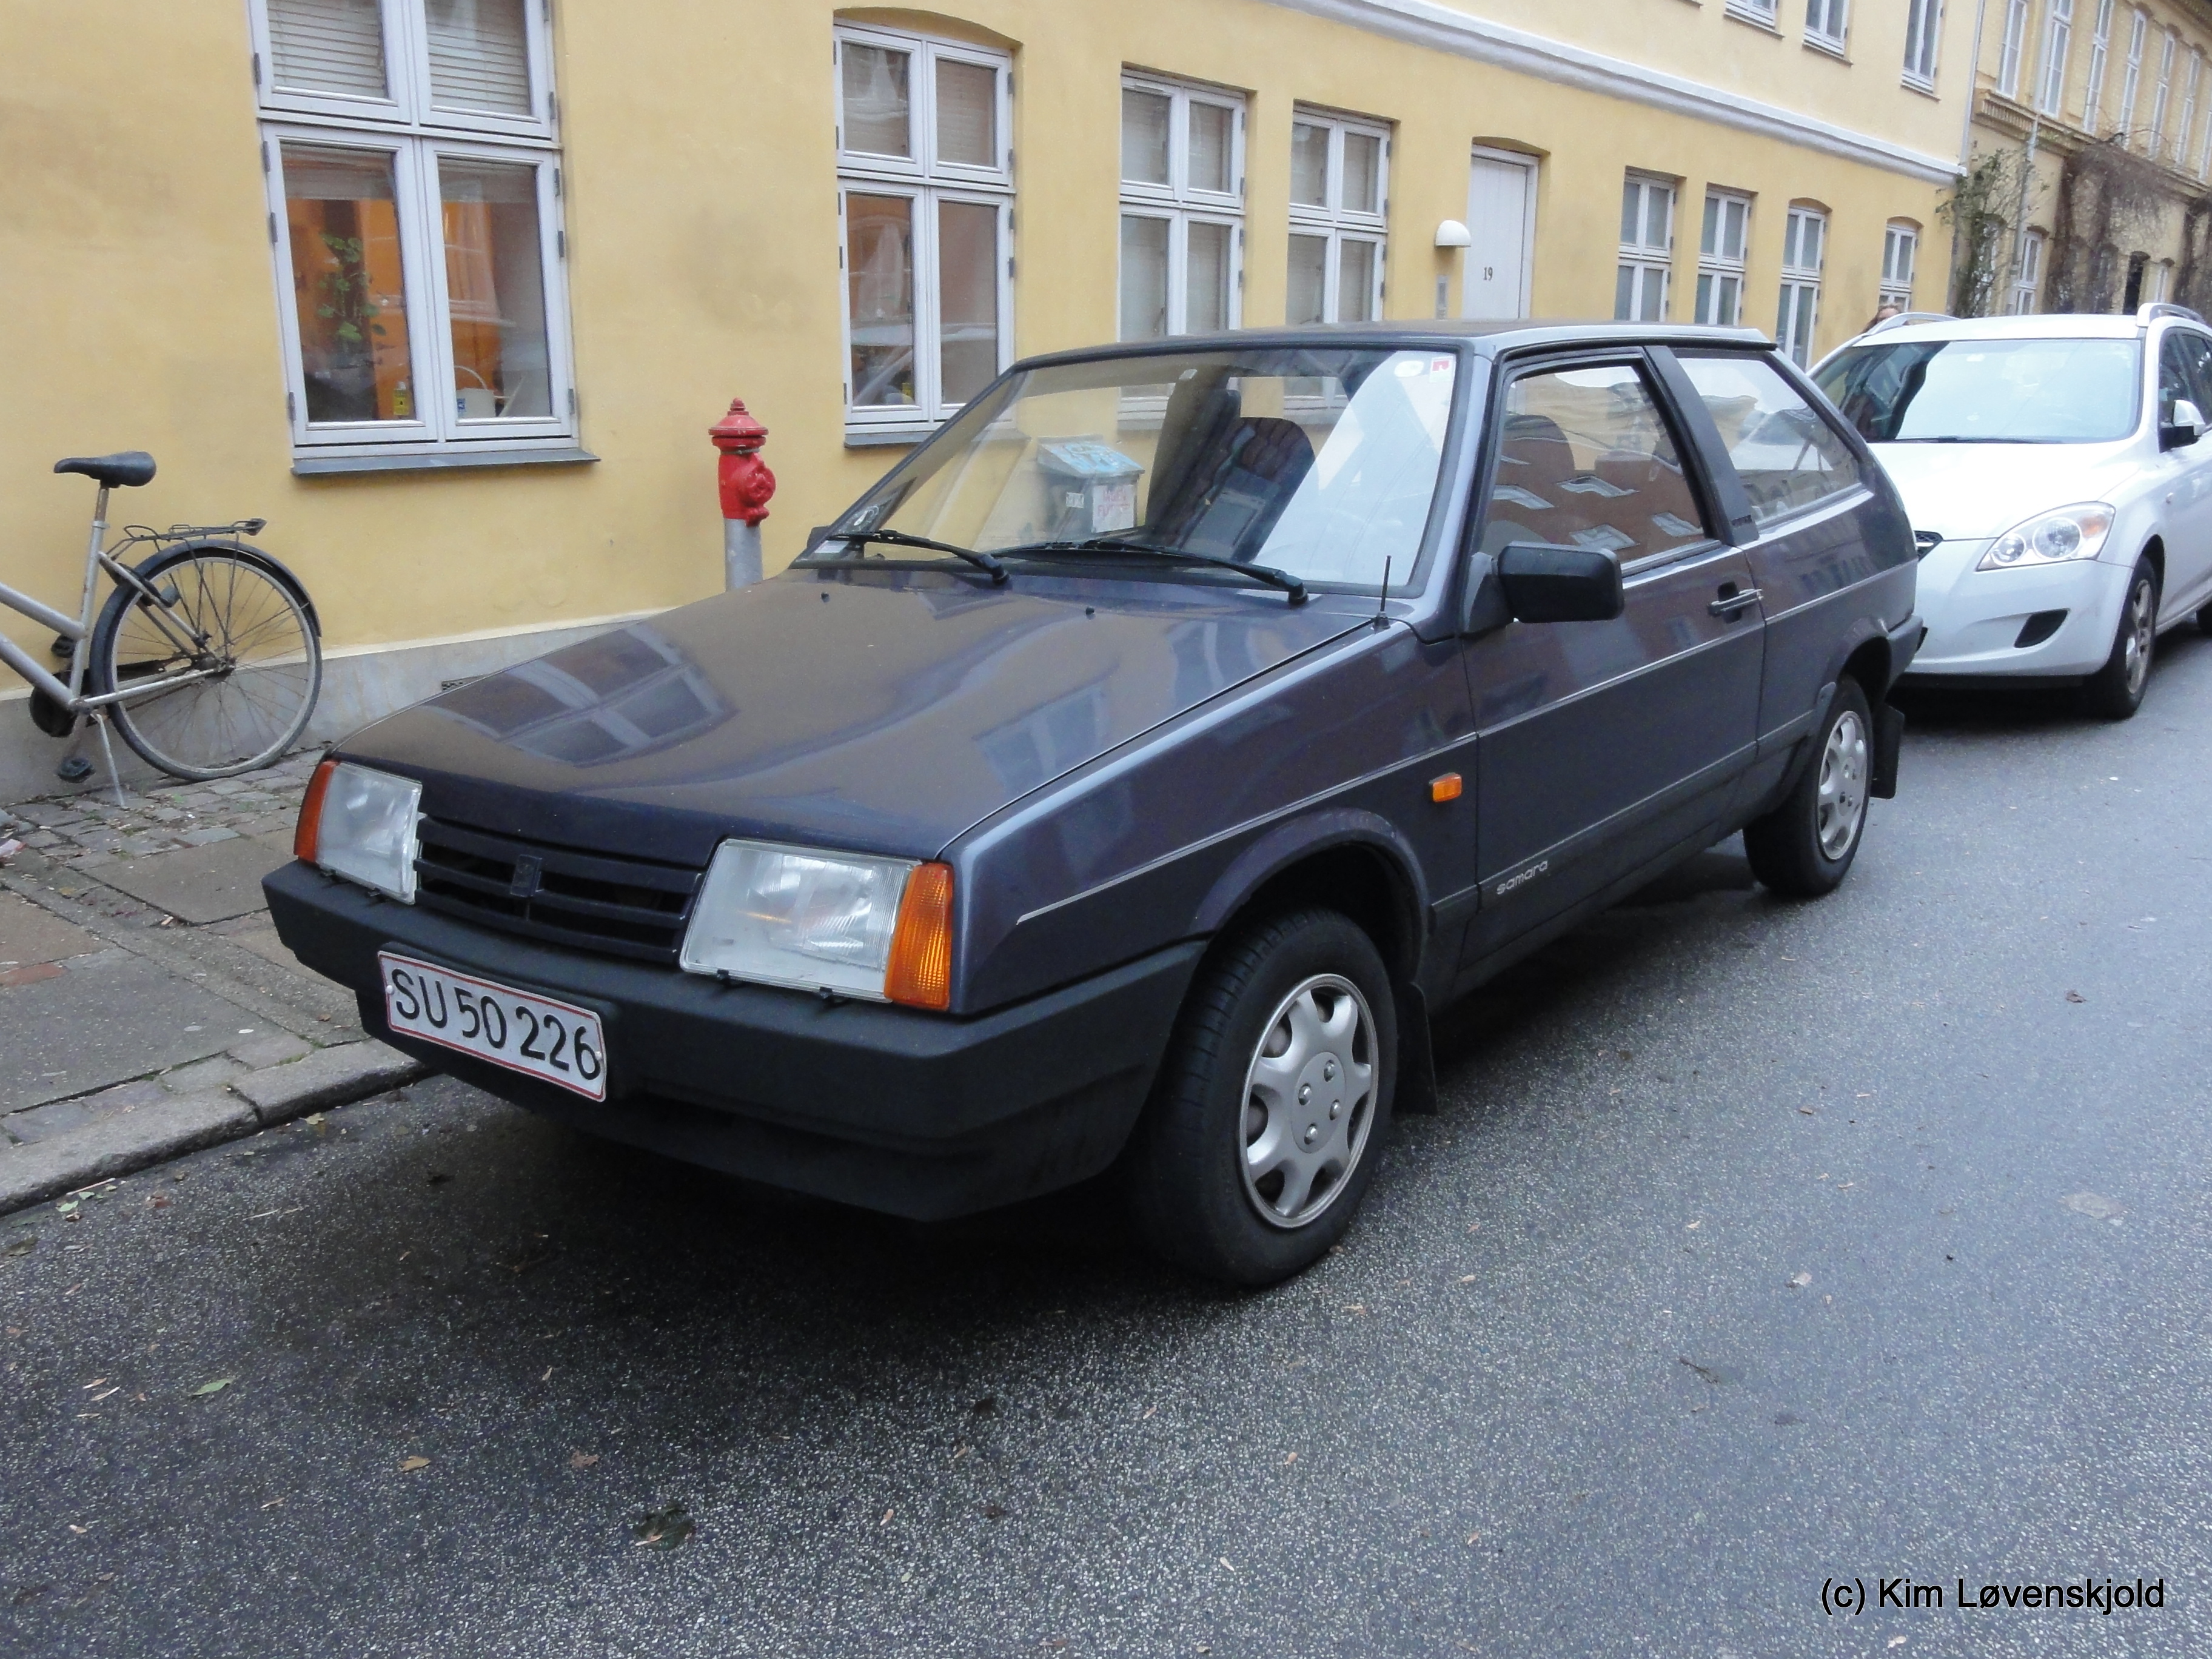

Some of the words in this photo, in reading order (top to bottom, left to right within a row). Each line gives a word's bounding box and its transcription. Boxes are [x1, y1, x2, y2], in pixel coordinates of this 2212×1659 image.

[1483, 267, 1493, 281] 19
[1496, 860, 1547, 895] samara
[391, 968, 448, 1029] SU
